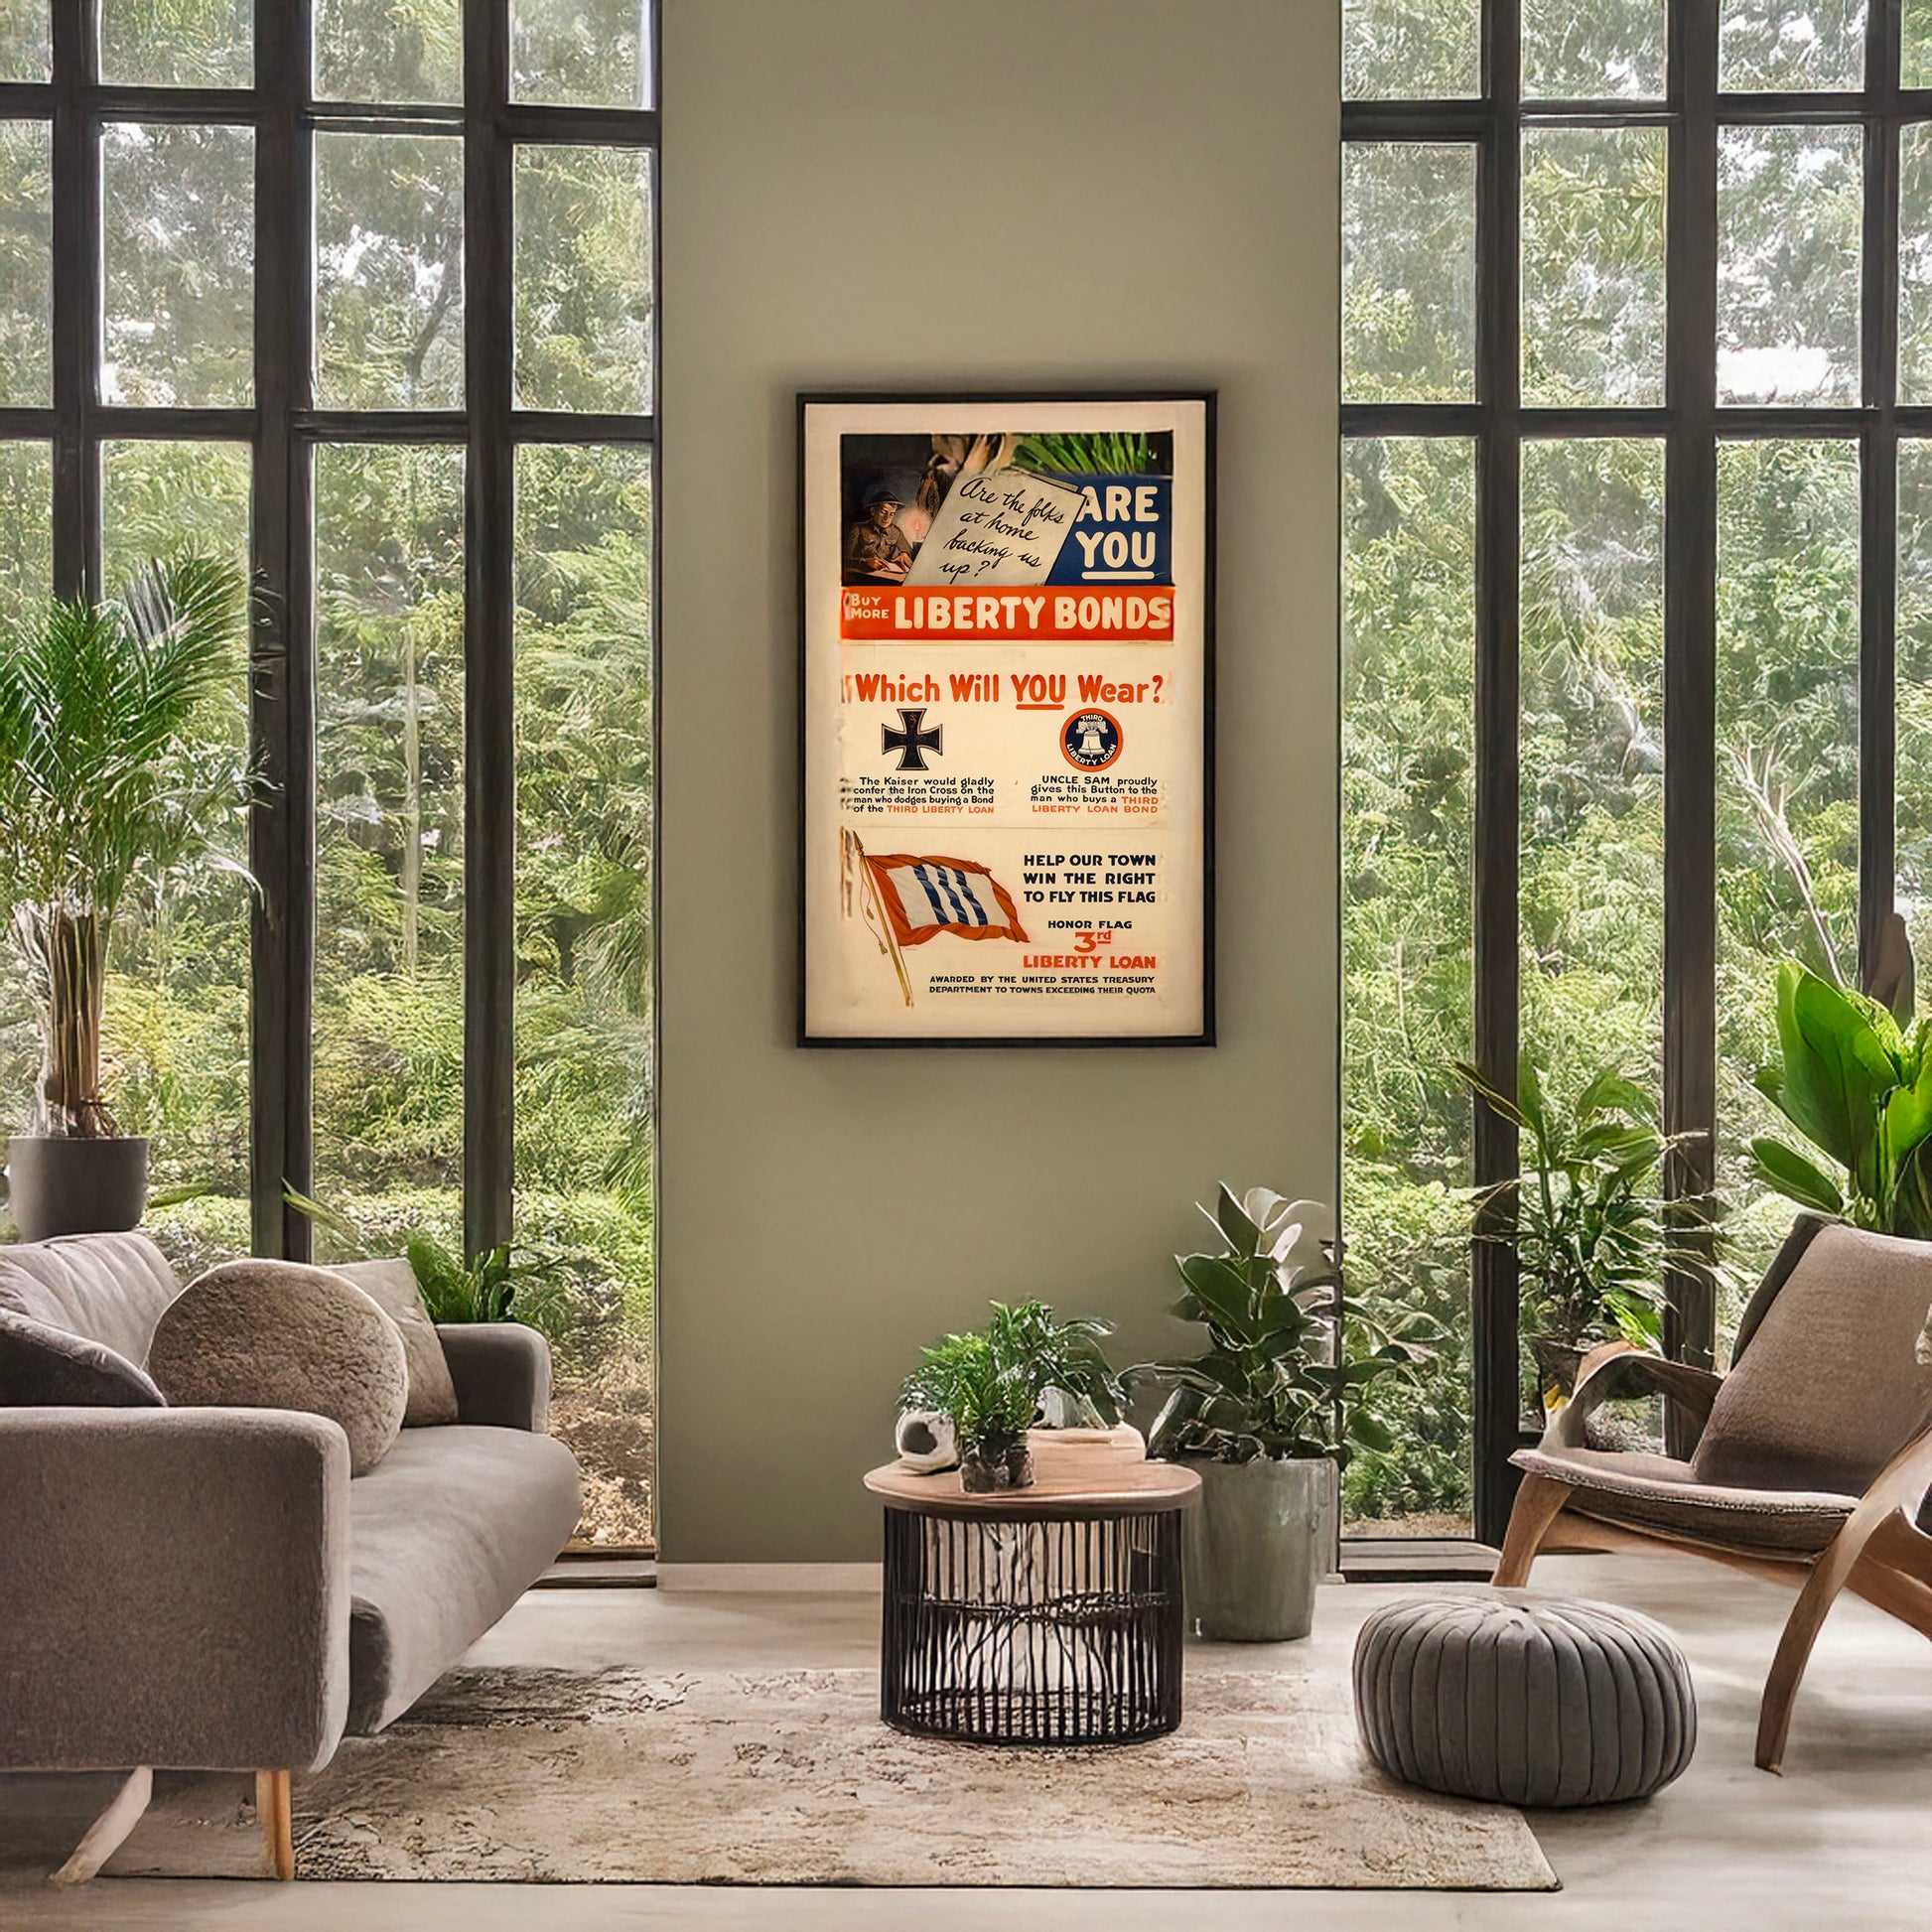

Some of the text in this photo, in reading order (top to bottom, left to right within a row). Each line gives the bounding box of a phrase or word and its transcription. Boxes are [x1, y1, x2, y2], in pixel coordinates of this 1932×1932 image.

[960, 478, 1064, 526] Are the folks
[1075, 485, 1159, 522] ARE
[960, 511, 1039, 541] at home
[943, 529, 1041, 570] backing us
[1076, 532, 1156, 568] YOU
[896, 597, 1171, 629] LIBERTY BONDS
[855, 674, 1164, 703] Which Will YOU Wear?
[1066, 743, 1117, 765] LIBERTY LOAN
[860, 776, 994, 790] The Kaiser would gladly
[1042, 775, 1078, 784] UNCLE
[1117, 776, 1158, 787] proudly
[1031, 785, 1062, 795] gives
[1090, 785, 1125, 794] Button
[895, 795, 926, 805] dodges
[929, 795, 962, 805] buying
[1082, 794, 1107, 804] buys
[1121, 796, 1159, 805] THIRD
[1024, 855, 1156, 866] HELP OUR TOWN
[1024, 873, 1156, 885] WIN THE RIGHT
[1024, 892, 1156, 902] TO FLY THIS FLAG
[1048, 920, 1133, 929] HONOR FLAG
[1024, 955, 1156, 969] LIBERTY LOAN
[1126, 986, 1156, 995] QUOTA
